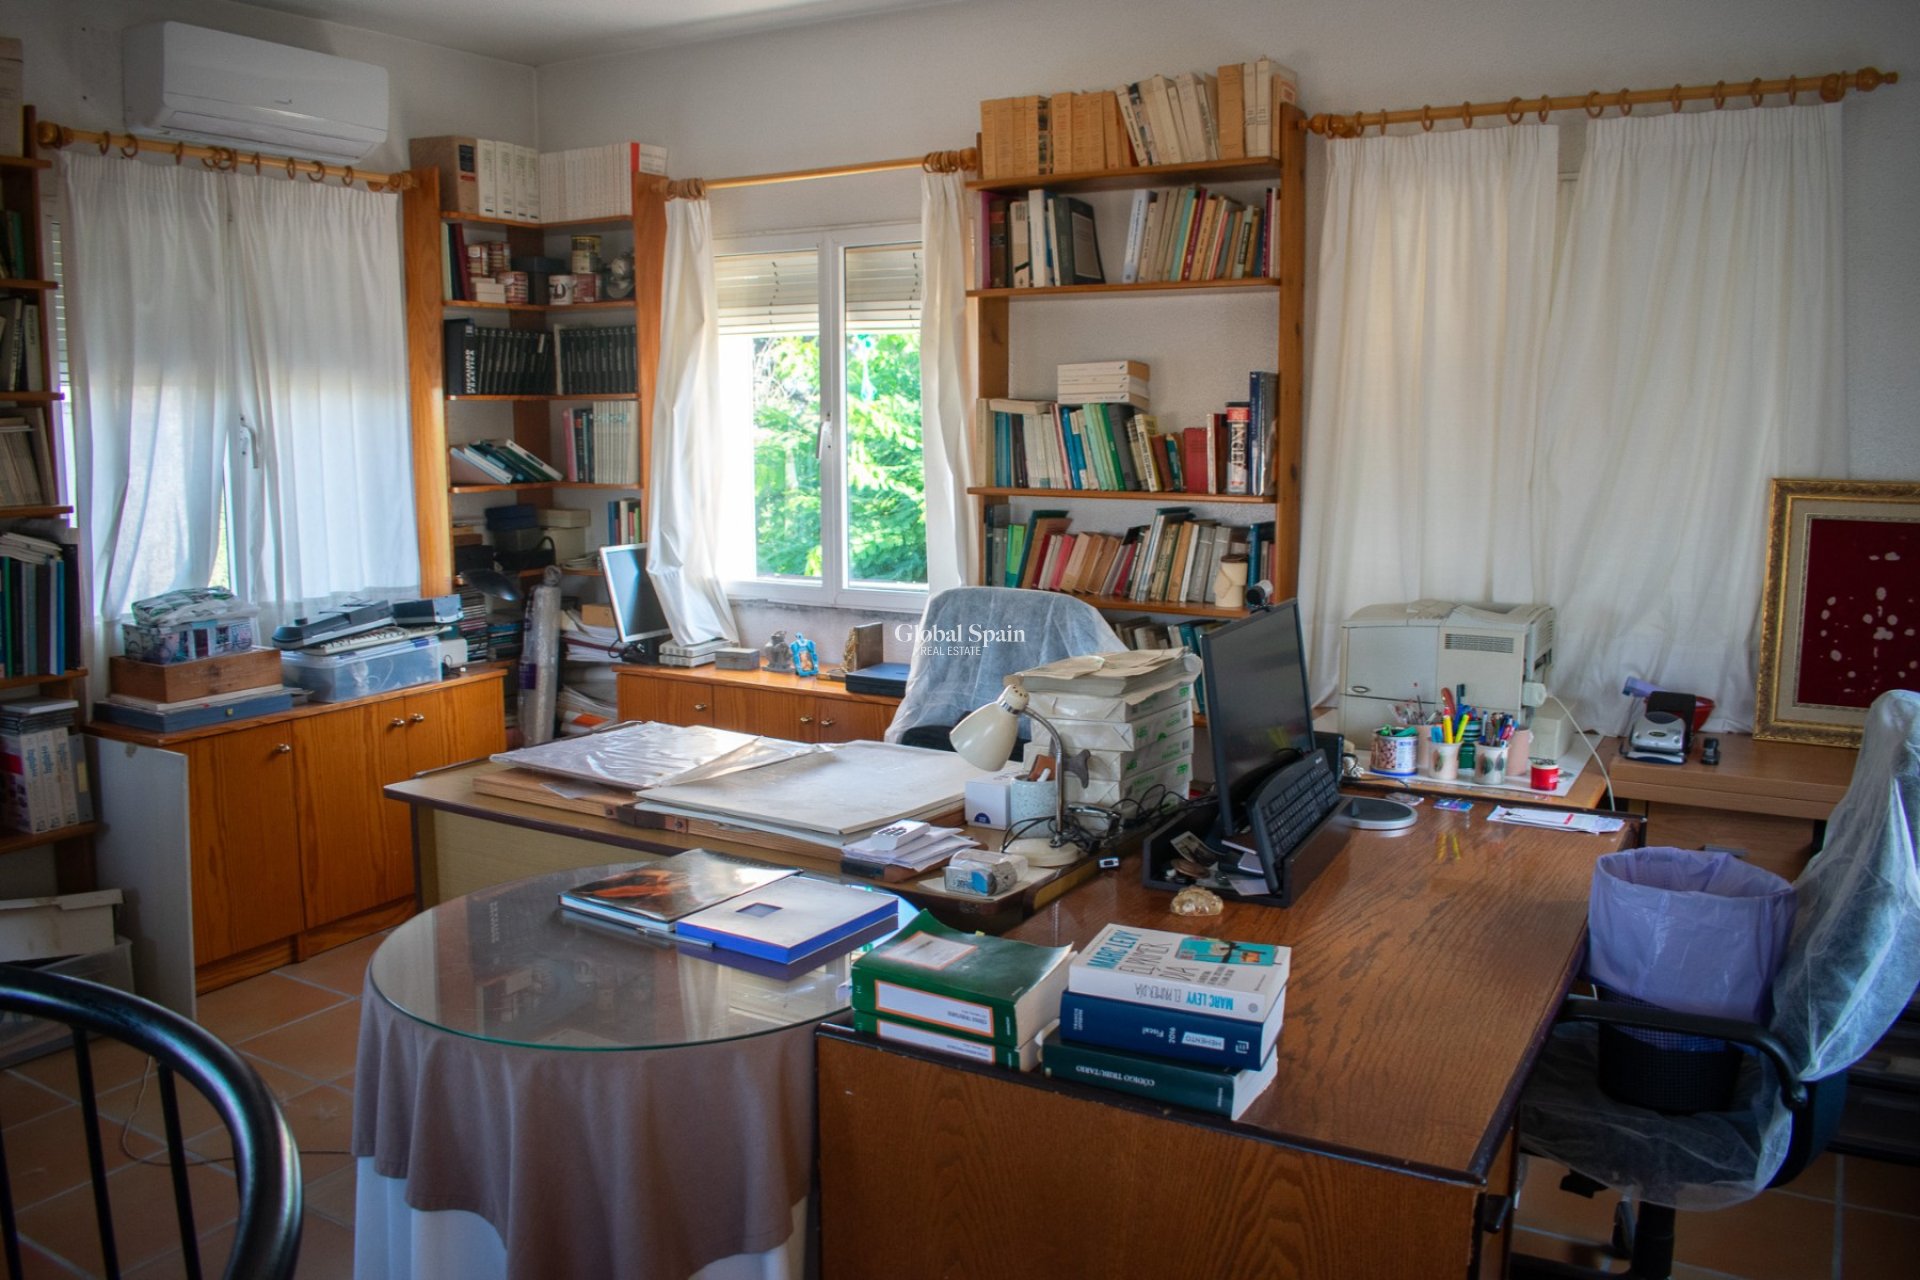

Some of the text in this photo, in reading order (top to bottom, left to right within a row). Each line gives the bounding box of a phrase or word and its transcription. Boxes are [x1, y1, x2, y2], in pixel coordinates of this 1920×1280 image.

[1106, 930, 1142, 949] LEVY
[1087, 946, 1128, 970] MARC
[1148, 985, 1173, 1001] PRIMER
[1173, 988, 1182, 1001] EL
[1186, 991, 1208, 1006] LEVY
[1208, 994, 1234, 1011] MARC
[1142, 1027, 1164, 1038] Fiscal
[1184, 1033, 1222, 1048] MEMENTO
[1075, 1065, 1156, 1087] CÓDIGO TRIBUTARIO
